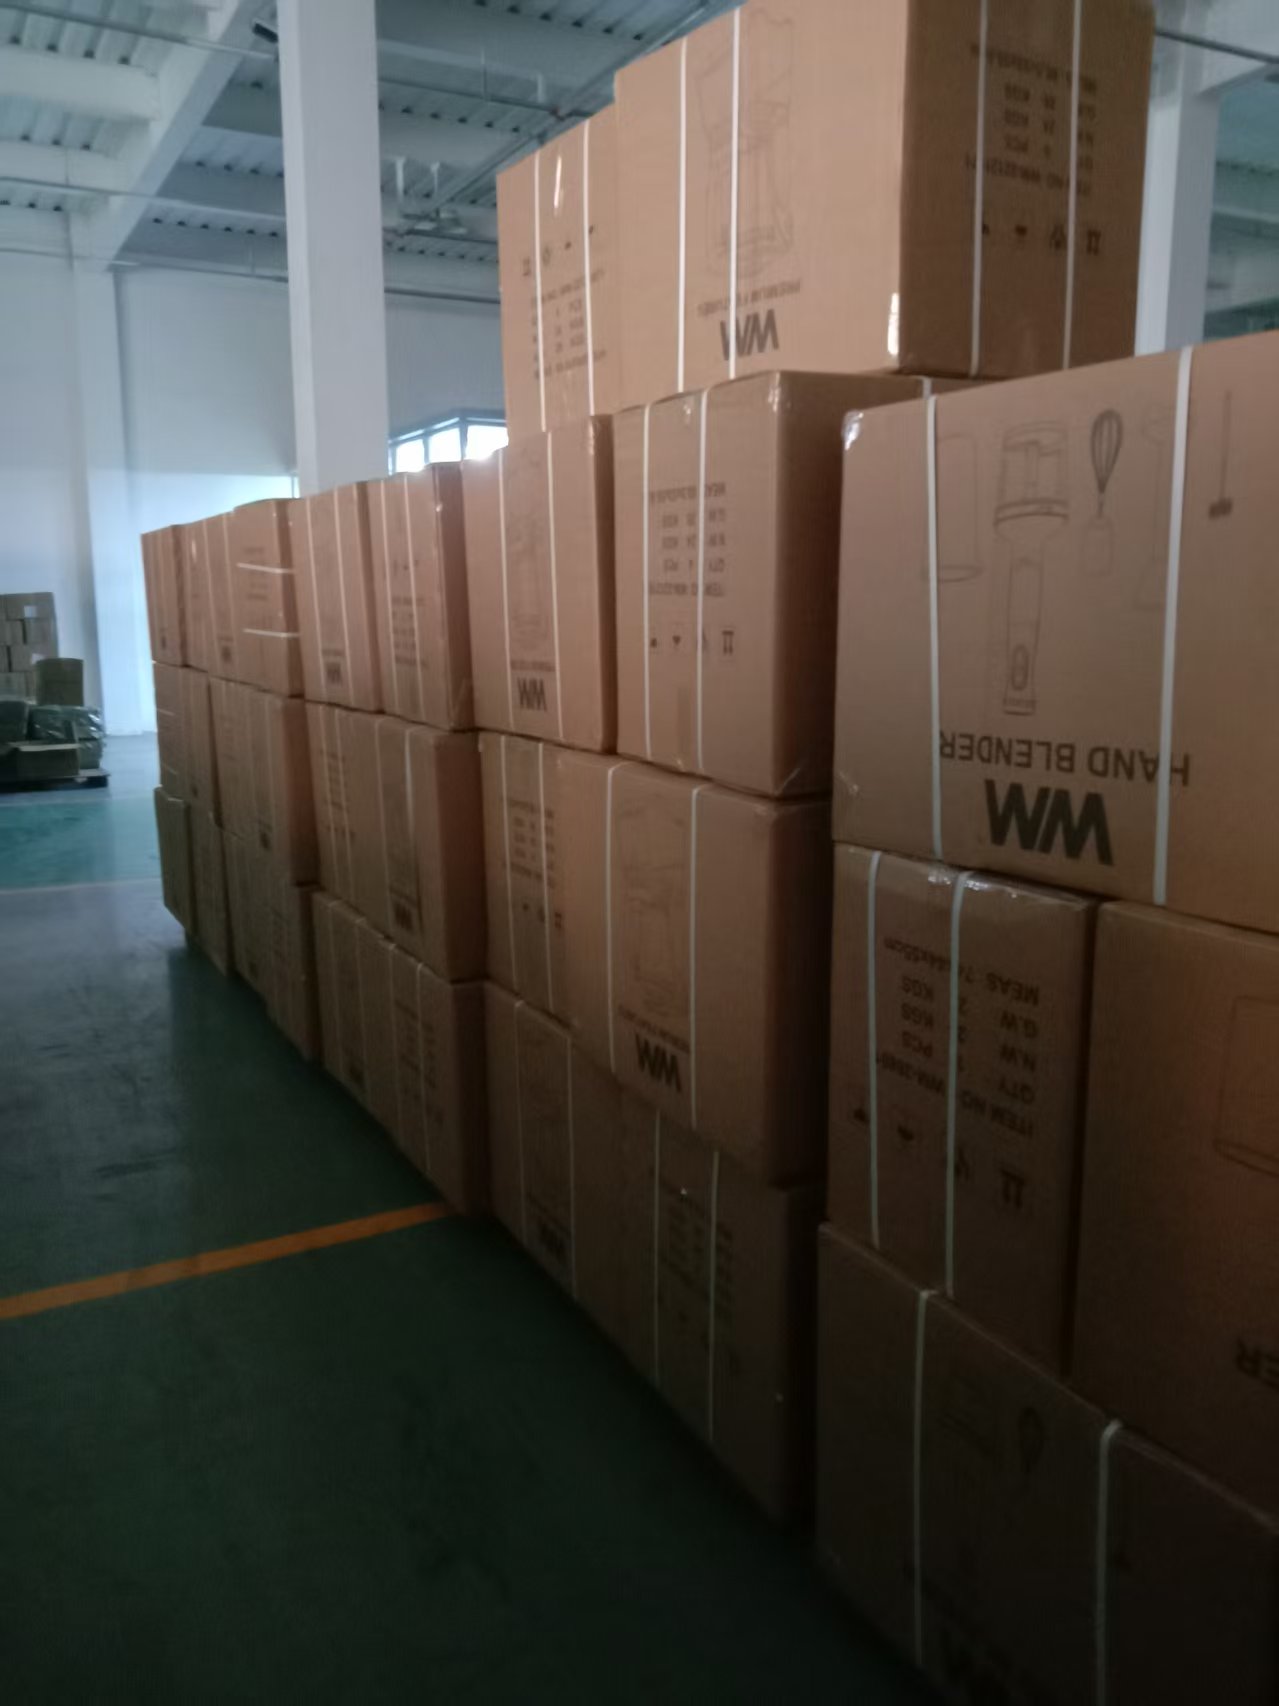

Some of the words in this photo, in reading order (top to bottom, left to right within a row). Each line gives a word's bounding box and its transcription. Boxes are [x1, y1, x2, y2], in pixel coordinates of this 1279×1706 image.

[939, 731, 1076, 774] BLENDER
[1088, 746, 1191, 787] HAND
[983, 779, 1114, 866] WM
